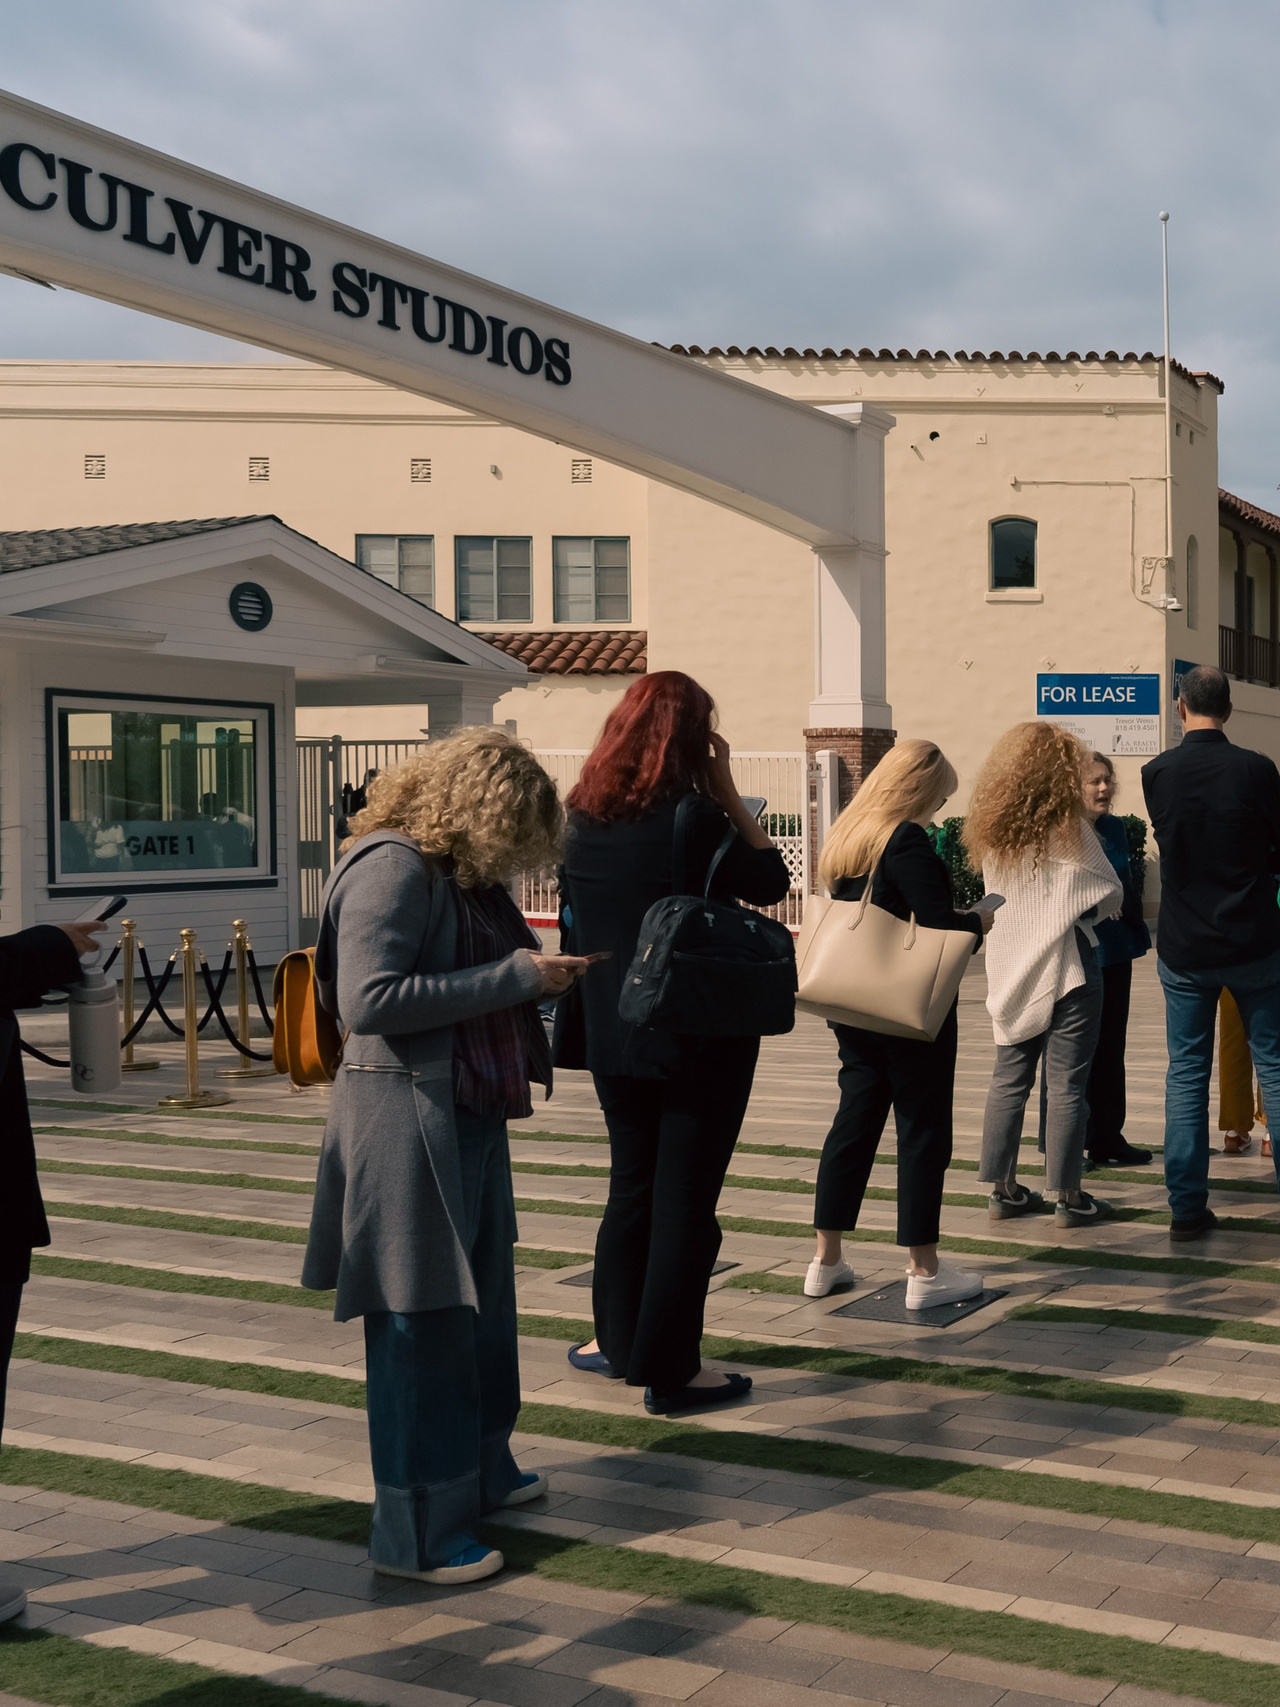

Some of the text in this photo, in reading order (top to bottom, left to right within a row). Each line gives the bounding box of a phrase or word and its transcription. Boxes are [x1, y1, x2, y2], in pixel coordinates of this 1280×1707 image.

[0, 142, 573, 386] CULVER STUDIOS
[1041, 686, 1136, 703] FOR LEASE
[125, 835, 195, 856] GATE 1
